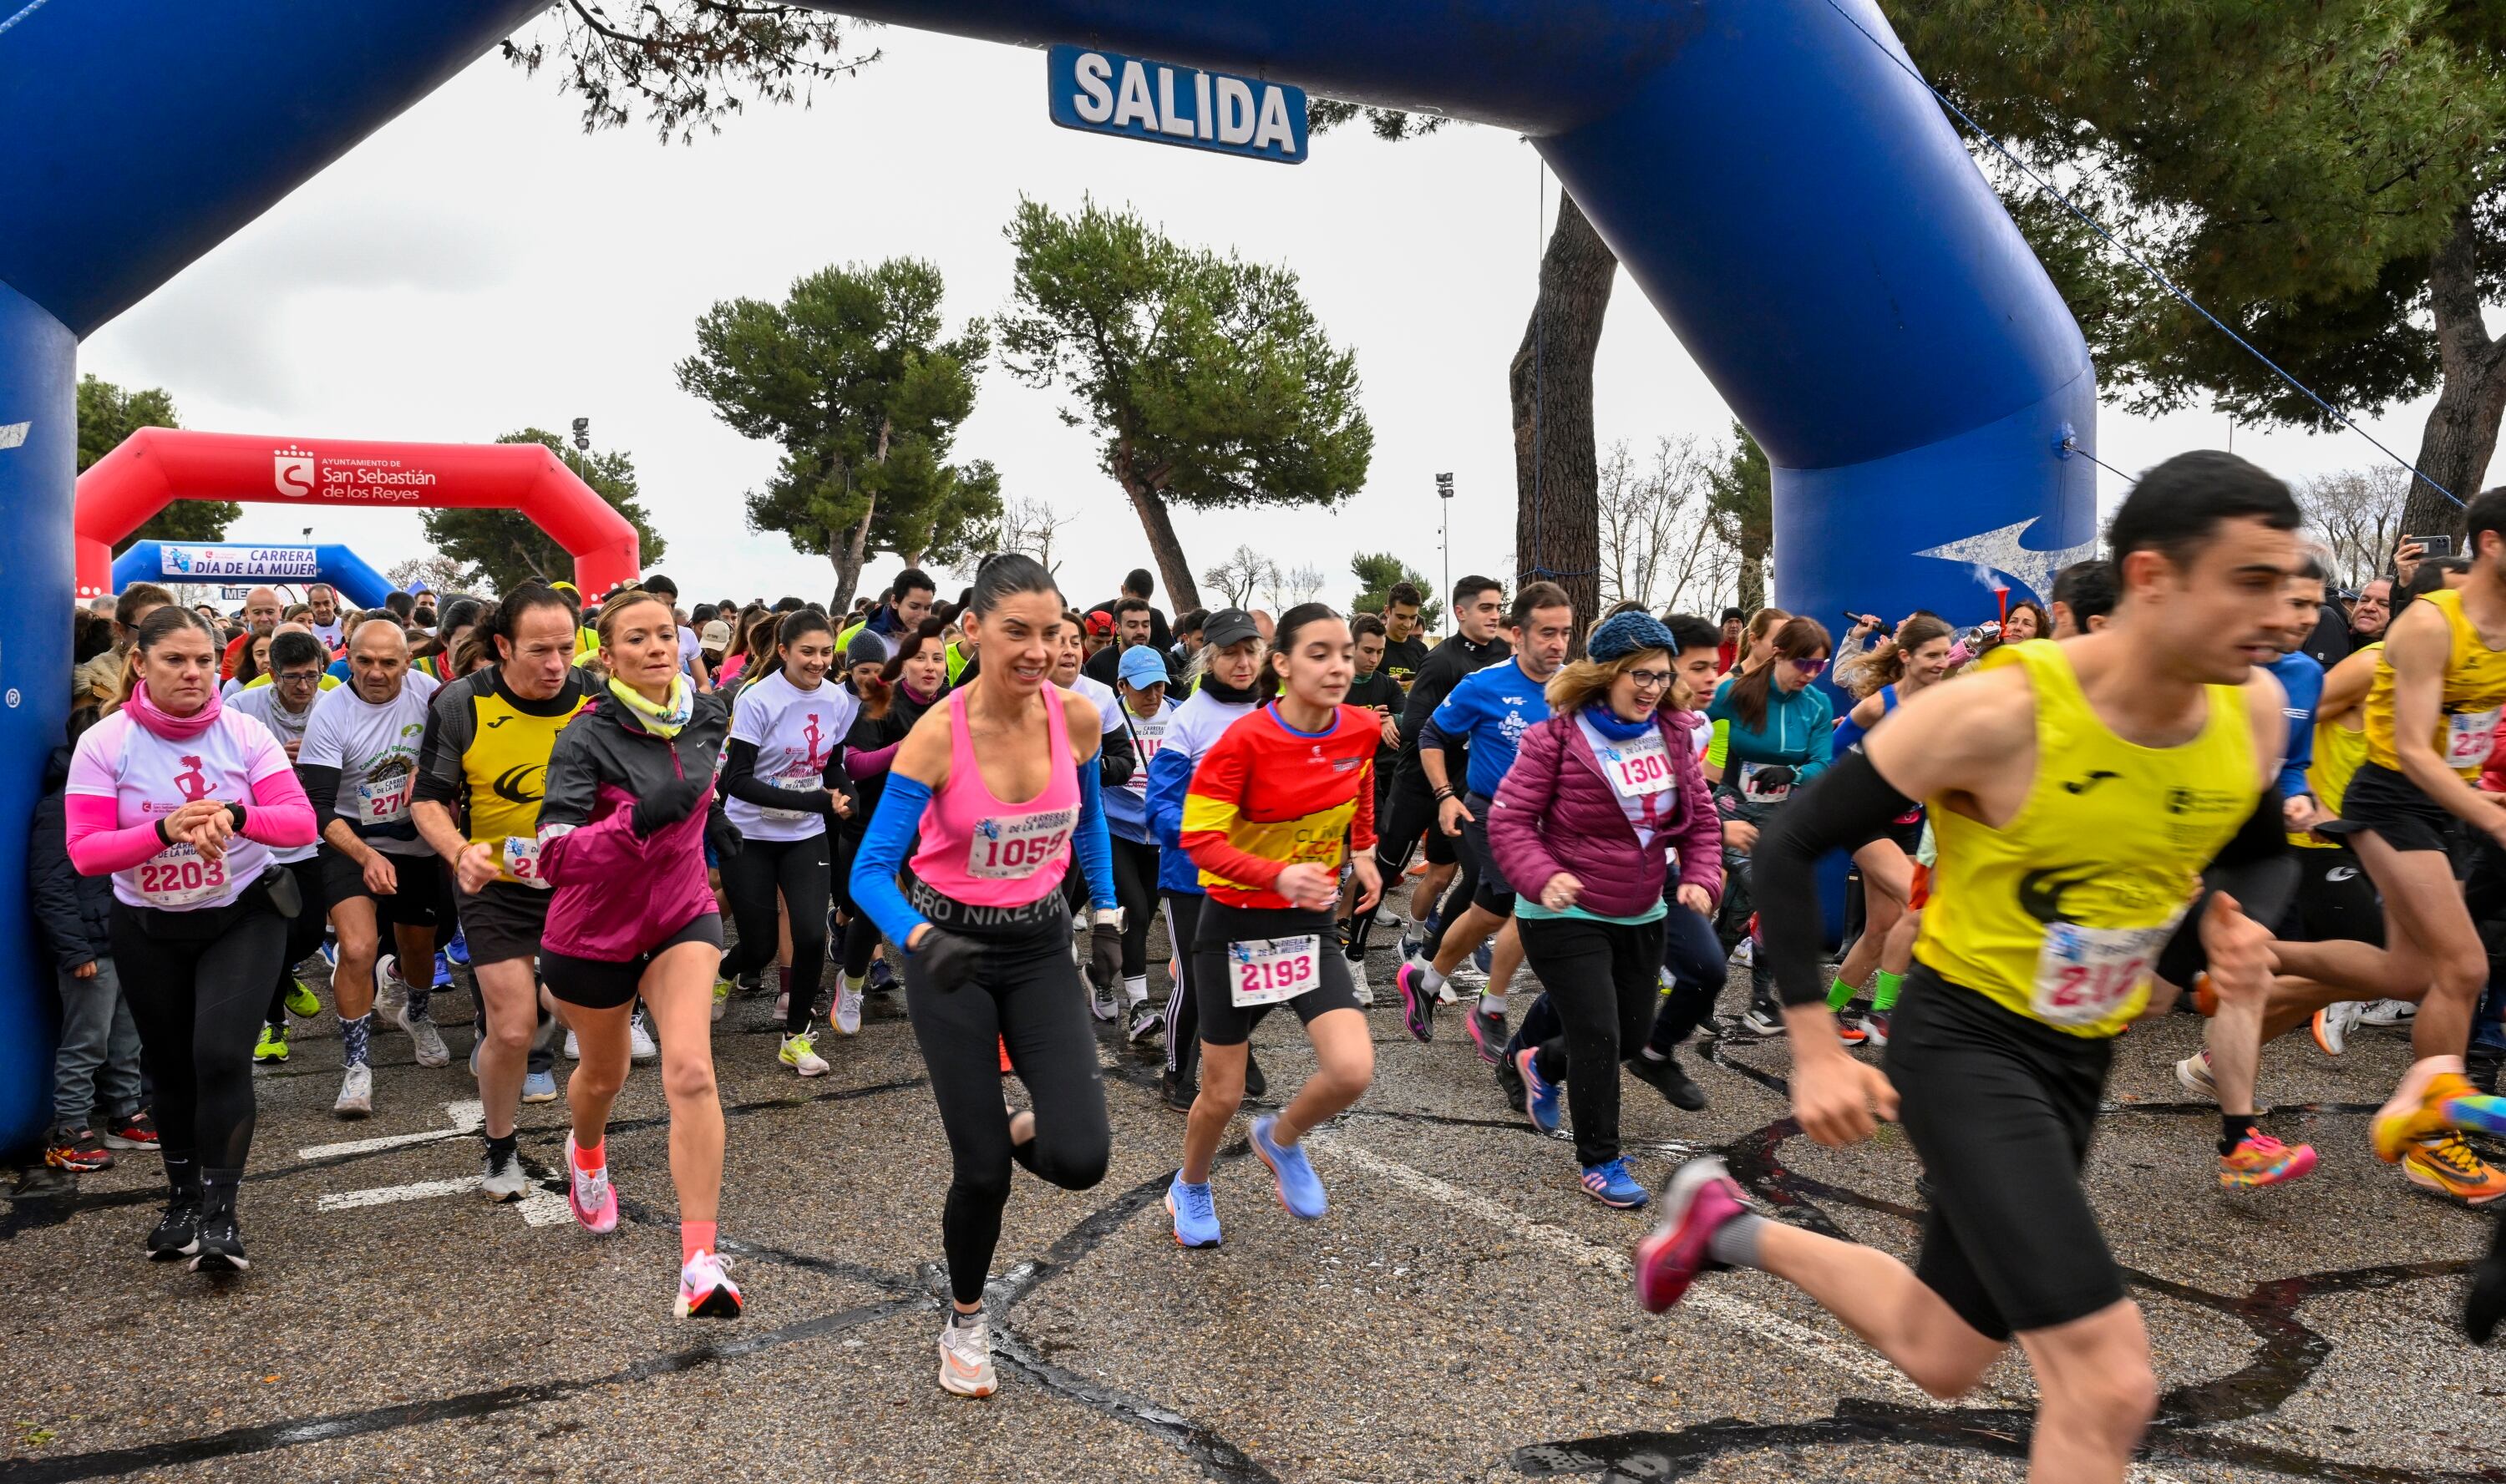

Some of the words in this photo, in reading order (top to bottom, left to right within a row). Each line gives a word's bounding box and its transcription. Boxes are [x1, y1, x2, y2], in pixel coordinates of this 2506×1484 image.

[1073, 53, 1296, 153] SALIDA
[322, 458, 388, 468] AYUNTAMIENTO
[322, 467, 353, 484] San
[357, 468, 436, 485] Sebastián
[322, 484, 343, 498] de
[347, 485, 369, 499] los
[373, 487, 419, 502] Reyes
[195, 560, 221, 574] DÍA
[225, 562, 243, 575] DE
[247, 563, 265, 575] LA
[269, 564, 317, 575] MUJER
[251, 550, 314, 562] CARRERA
[225, 589, 249, 600] ME
[359, 749, 388, 770] Camino
[391, 745, 420, 756] Blanco
[1619, 752, 1674, 785] 1301
[986, 828, 1068, 867] 1059
[141, 859, 224, 893] 2203
[911, 888, 952, 920] PRO
[962, 904, 1030, 925] NIKE
[1240, 955, 1311, 991] 2193
